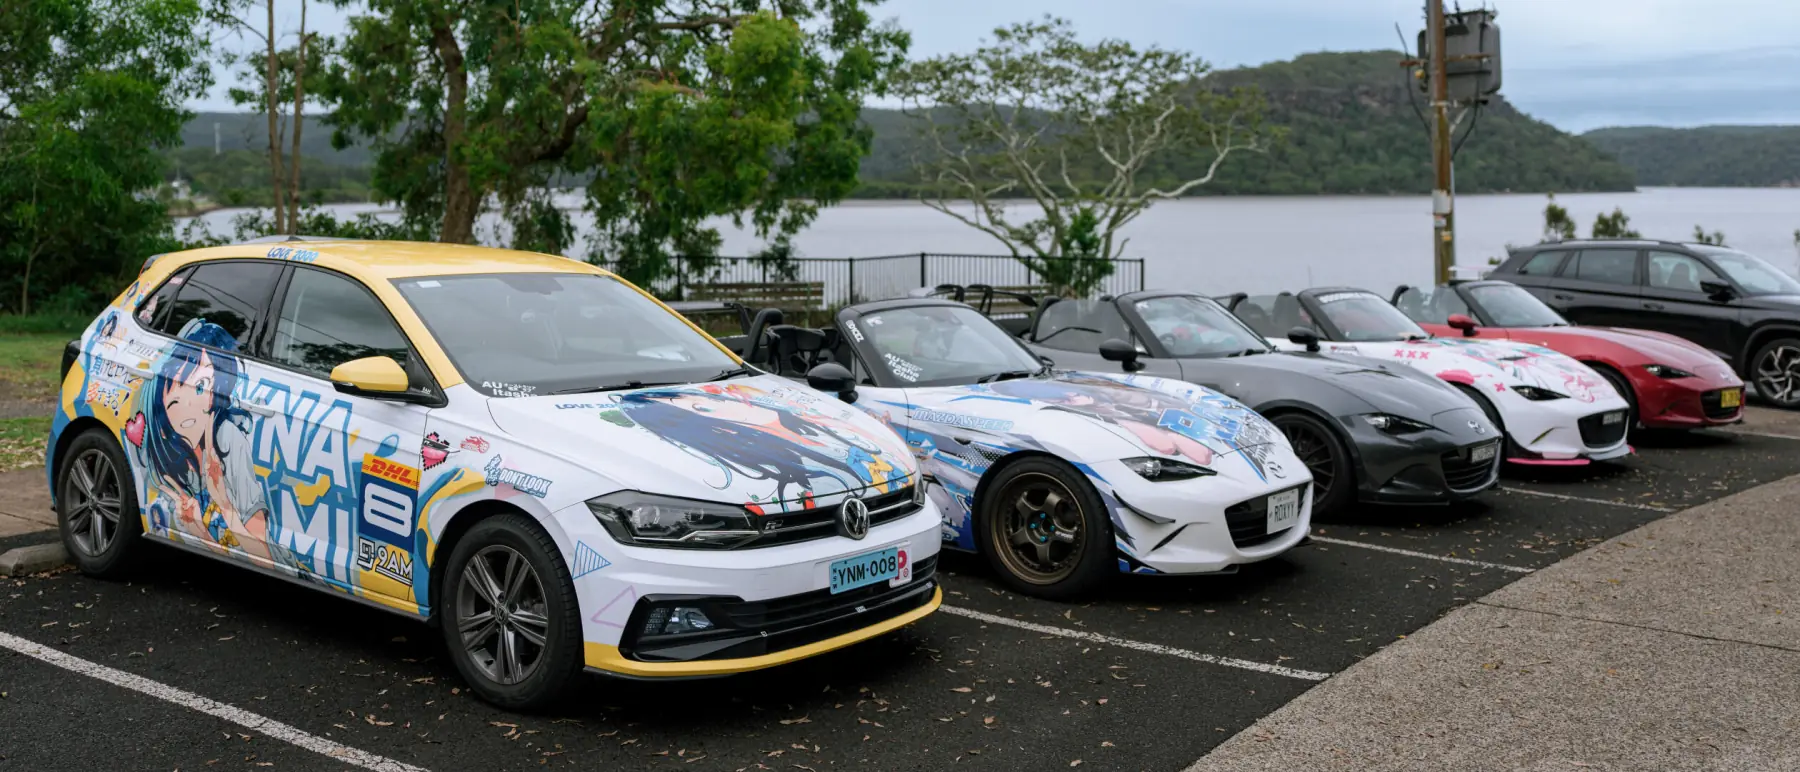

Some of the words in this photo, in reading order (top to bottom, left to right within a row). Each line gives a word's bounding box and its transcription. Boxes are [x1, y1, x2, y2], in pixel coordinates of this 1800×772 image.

[884, 353, 900, 362] AU
[889, 360, 920, 378] Itasha
[893, 369, 917, 382] Club
[482, 381, 502, 393] AU
[912, 408, 1015, 431] MAZDASPEED
[370, 458, 412, 484] DHL
[522, 475, 551, 494] LOOK
[364, 482, 413, 538] 8
[377, 546, 413, 581] 9AM
